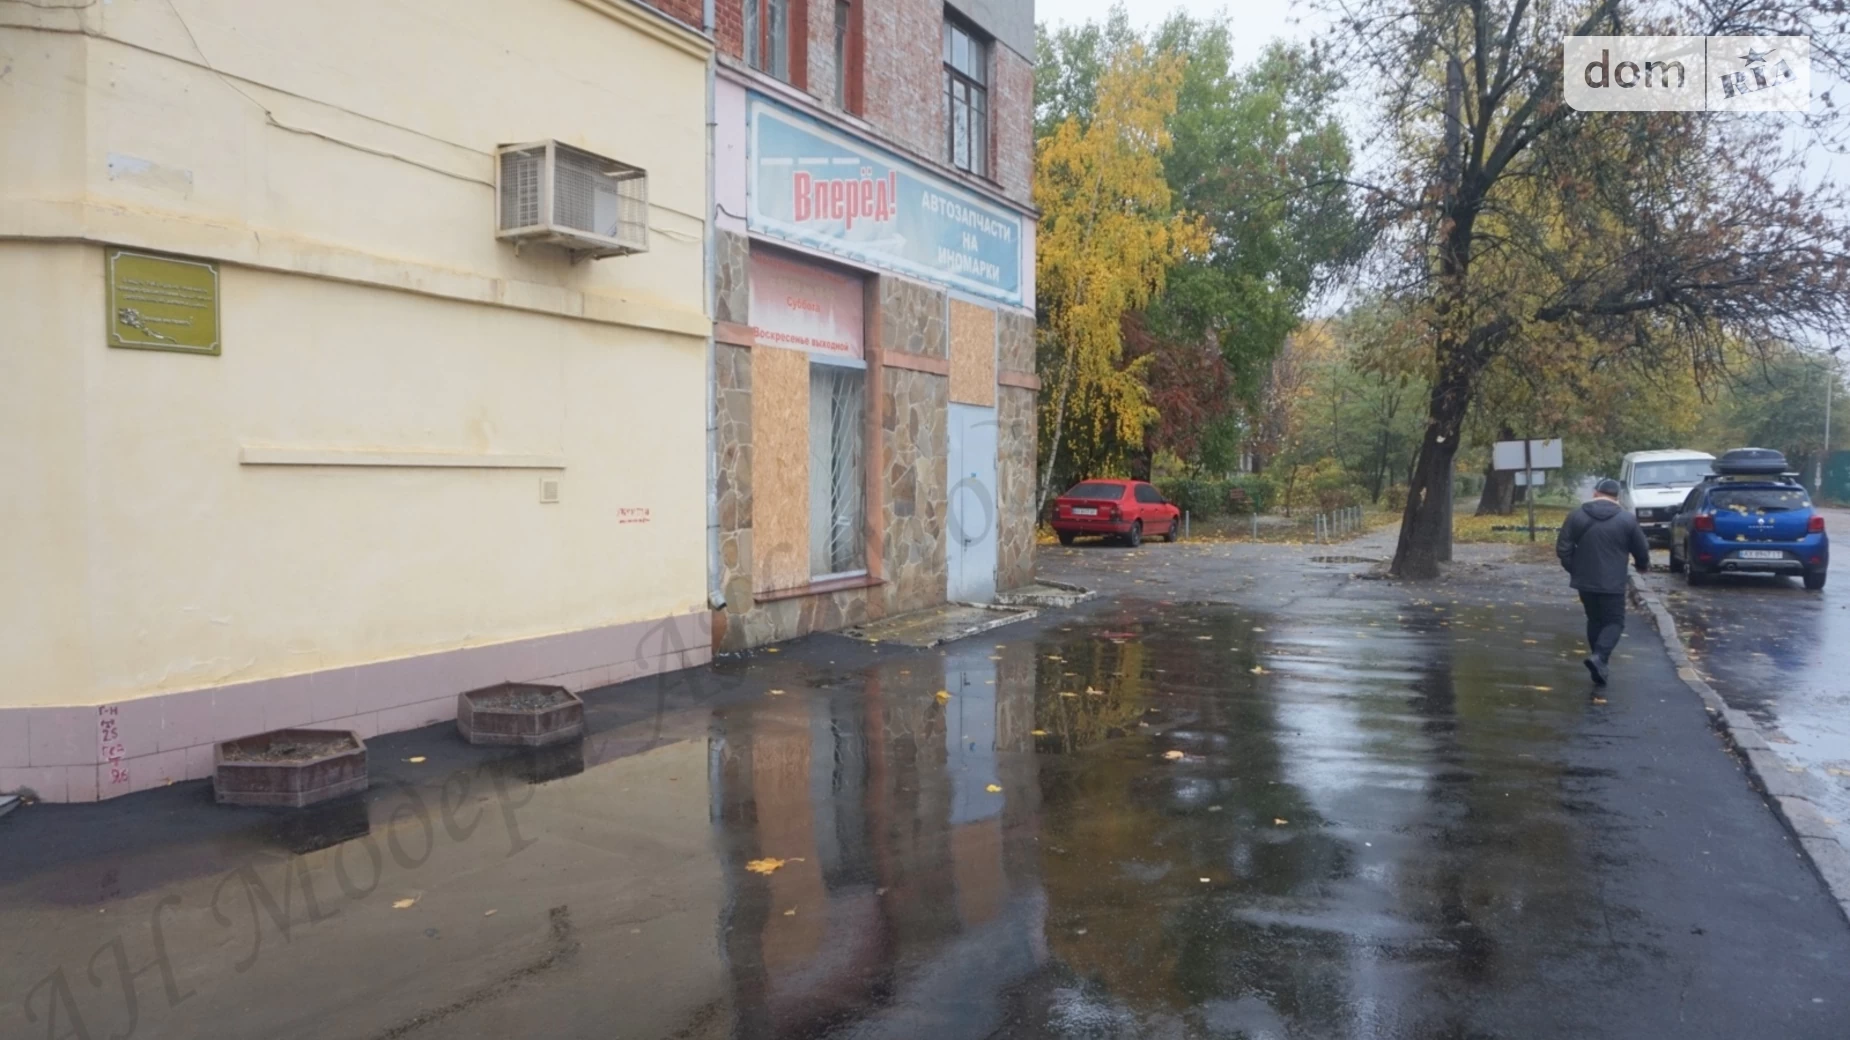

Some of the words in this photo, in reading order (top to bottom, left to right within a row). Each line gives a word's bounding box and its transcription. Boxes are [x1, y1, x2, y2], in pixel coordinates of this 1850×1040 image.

[792, 165, 897, 229] Вперёд!
[922, 190, 1011, 243] АВТОЗАПЧАСТИ
[962, 232, 979, 252] НА
[937, 246, 1000, 282] ИНОМАРКИ
[786, 296, 822, 314] Суббота
[753, 326, 809, 346] Воскресенье
[811, 337, 850, 353] выходной
